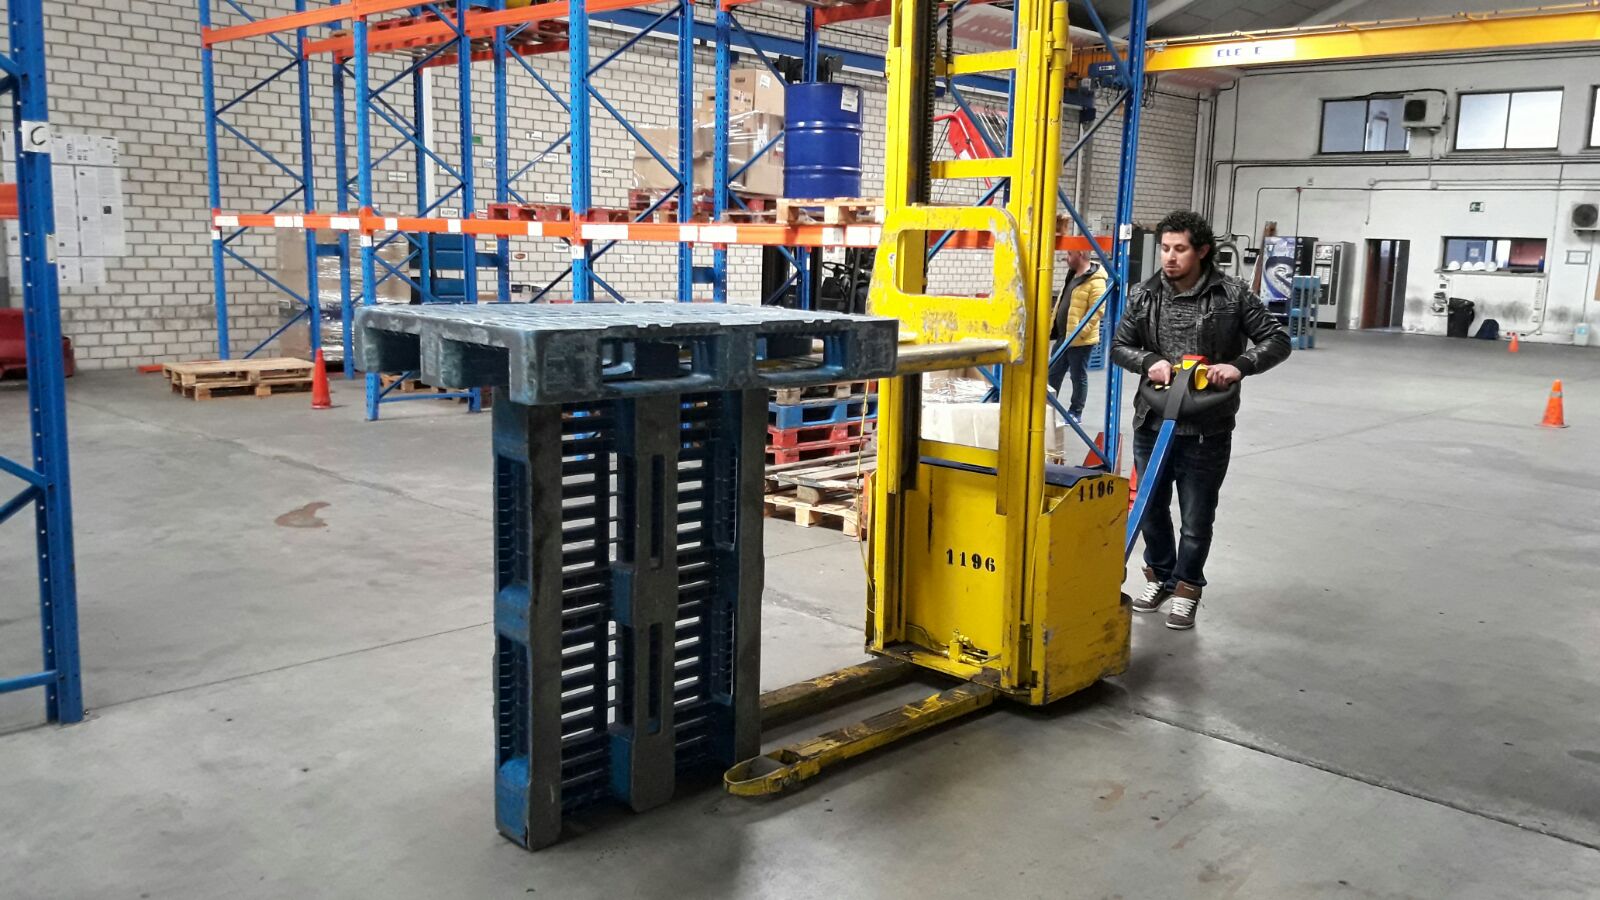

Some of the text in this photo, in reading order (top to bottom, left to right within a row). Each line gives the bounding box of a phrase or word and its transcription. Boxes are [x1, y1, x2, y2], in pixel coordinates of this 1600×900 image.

[30, 125, 47, 146] C
[1077, 479, 1115, 502] 1196
[946, 548, 996, 573] 1196
